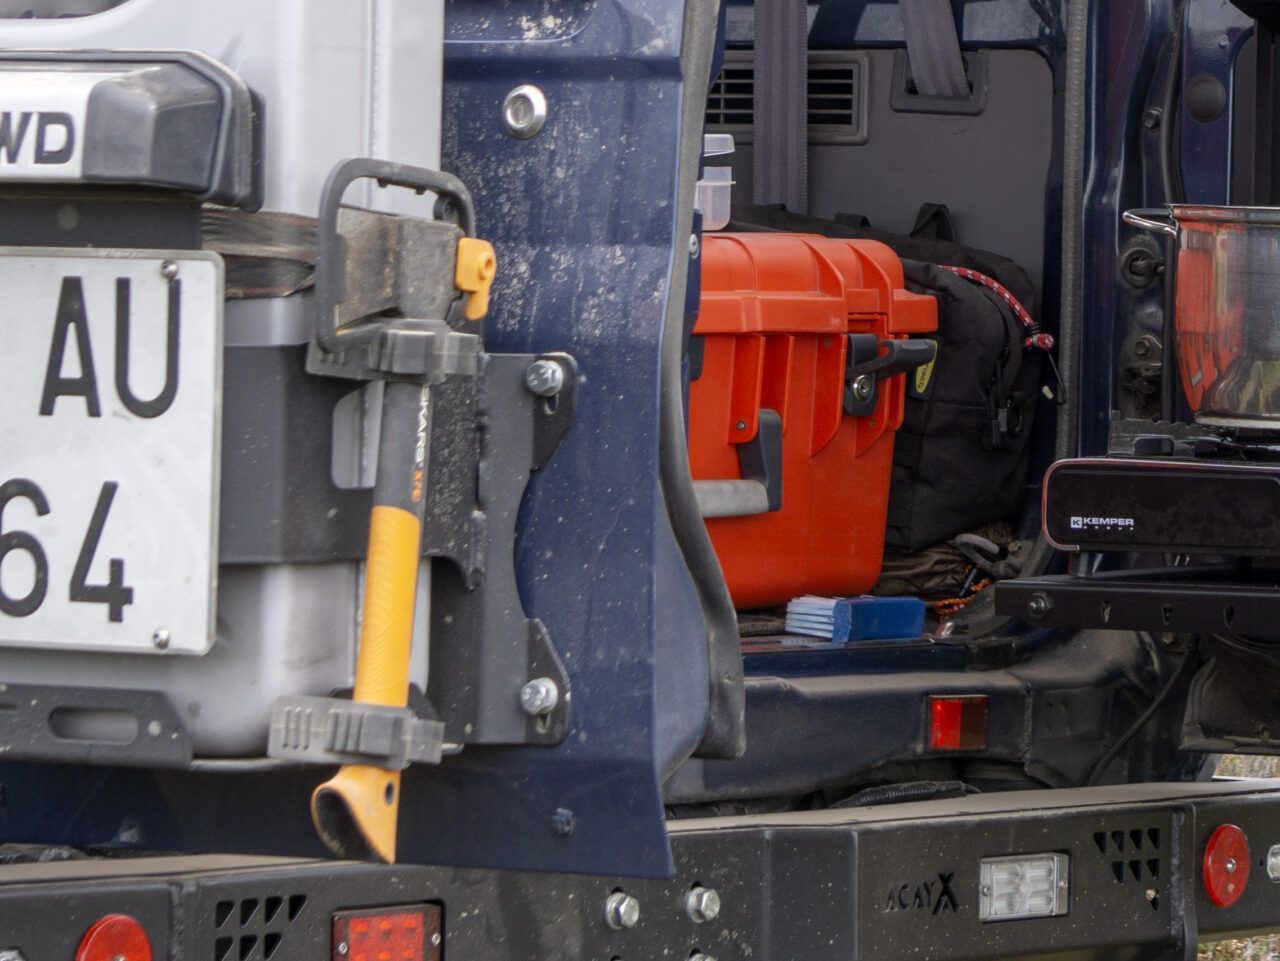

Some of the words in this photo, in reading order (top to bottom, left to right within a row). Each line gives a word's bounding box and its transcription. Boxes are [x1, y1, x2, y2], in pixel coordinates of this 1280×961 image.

[39, 276, 181, 419] AU
[0, 478, 135, 623] 64
[1083, 517, 1135, 526] KEMPER
[885, 872, 959, 915] ACAYX
